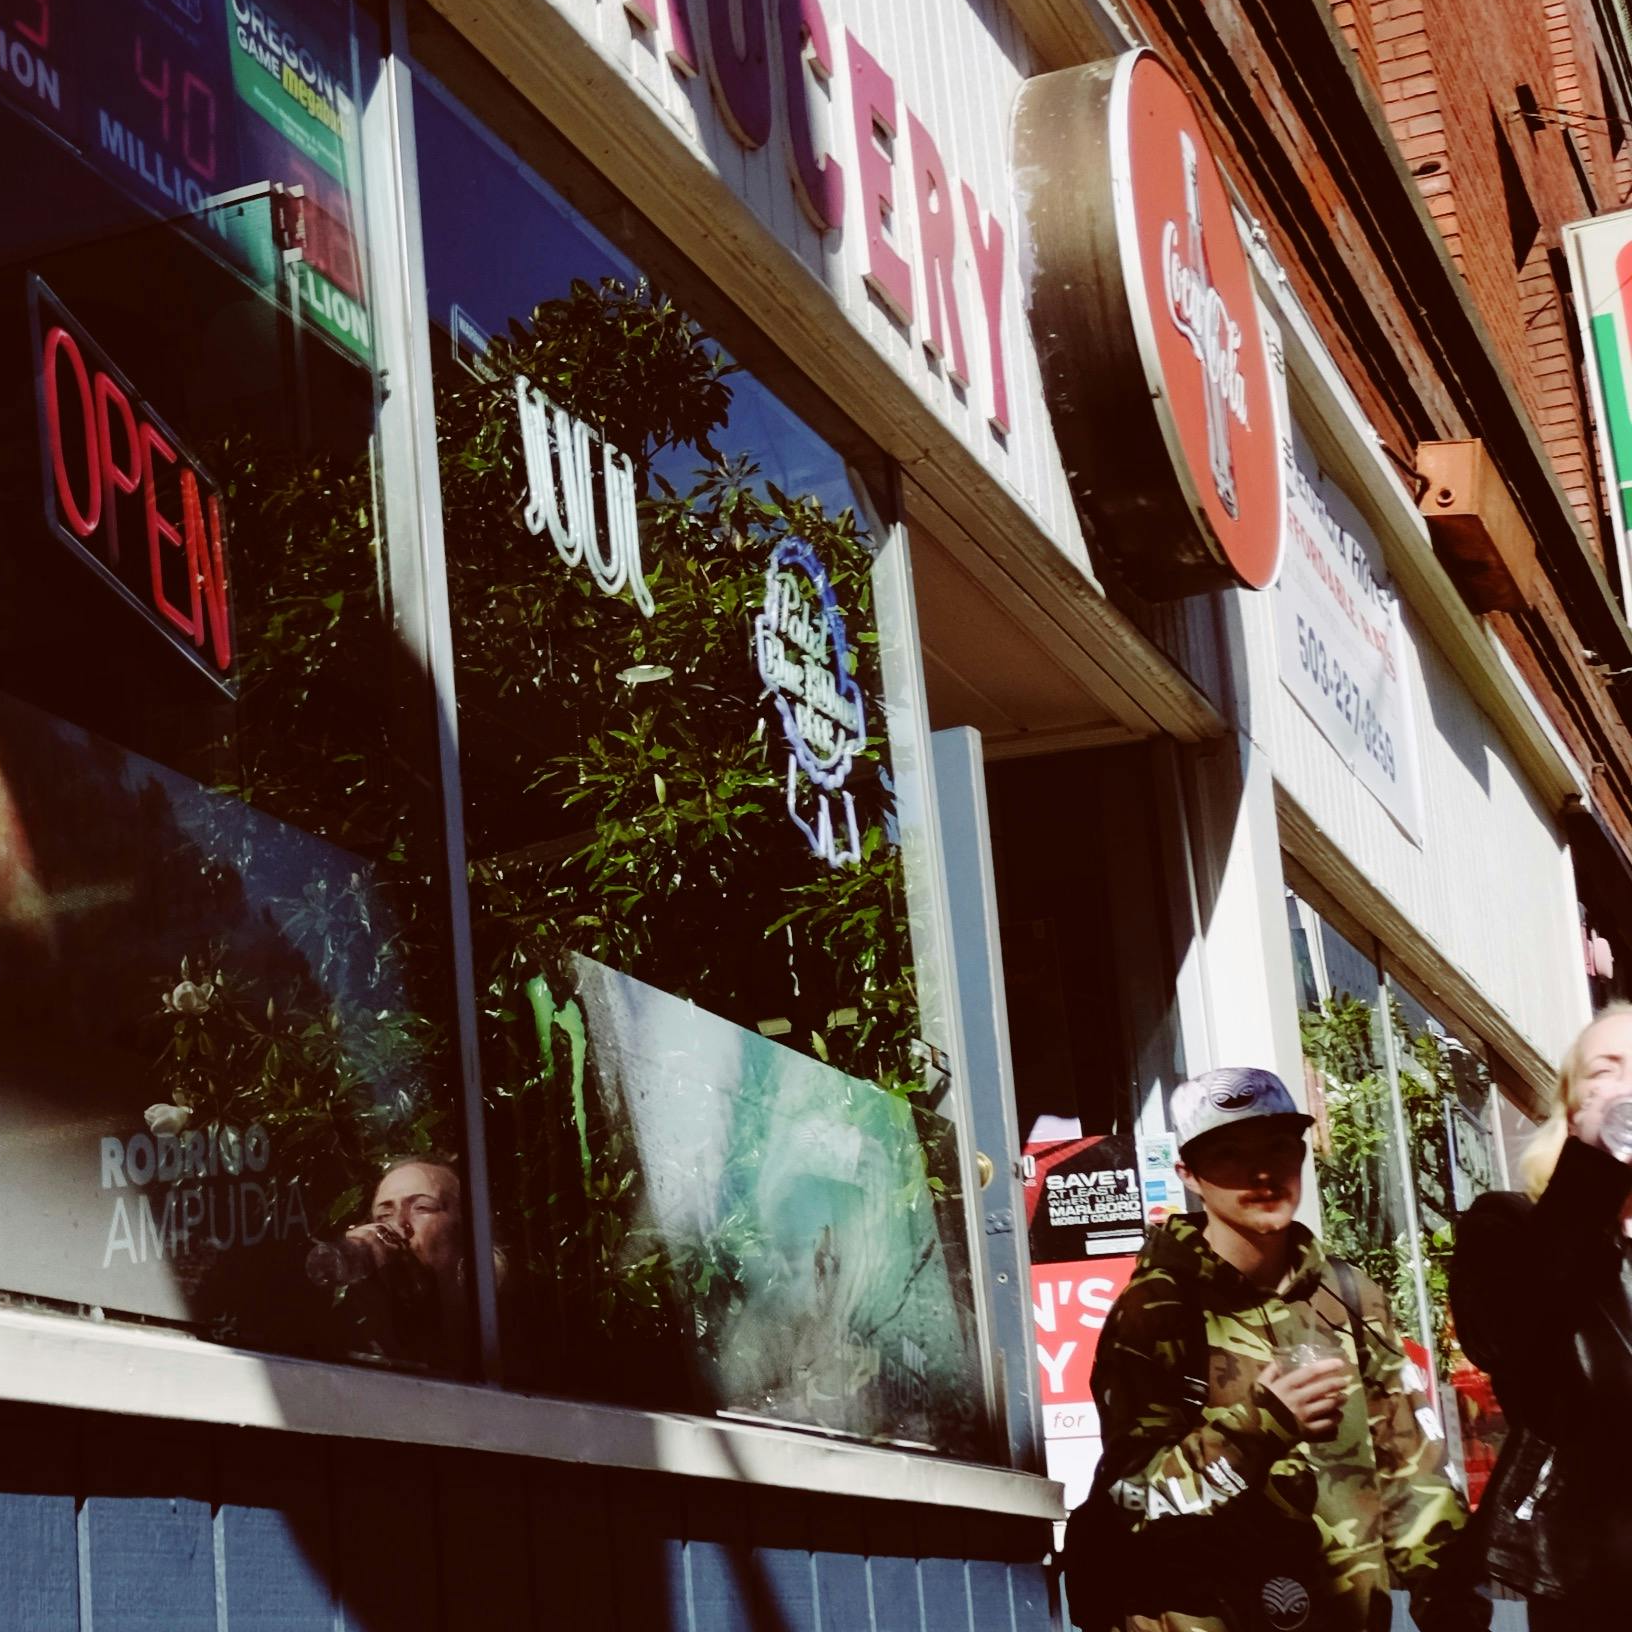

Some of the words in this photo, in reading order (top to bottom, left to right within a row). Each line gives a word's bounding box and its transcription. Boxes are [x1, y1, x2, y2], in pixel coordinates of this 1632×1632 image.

[236, 25, 281, 80] GAME
[133, 32, 217, 181] 40
[98, 108, 228, 240] MILLION
[43, 324, 232, 672] OPEN
[514, 372, 656, 619] JUUL
[776, 571, 831, 666] Pabst
[763, 629, 805, 696] Blue
[100, 1121, 271, 1190] RODRIGO
[1045, 1171, 1116, 1190] SAVE
[102, 1179, 311, 1270] AMPUDIA
[1047, 1189, 1068, 1200] AT
[1069, 1185, 1117, 1198] LEAST
[1048, 1197, 1089, 1207] WHEN
[1095, 1192, 1139, 1203] USING
[1048, 1200, 1141, 1218] MARLBORO
[1050, 1215, 1089, 1226] MOBILE
[1090, 1210, 1142, 1224] COUPONS
[1053, 1411, 1086, 1430] for
